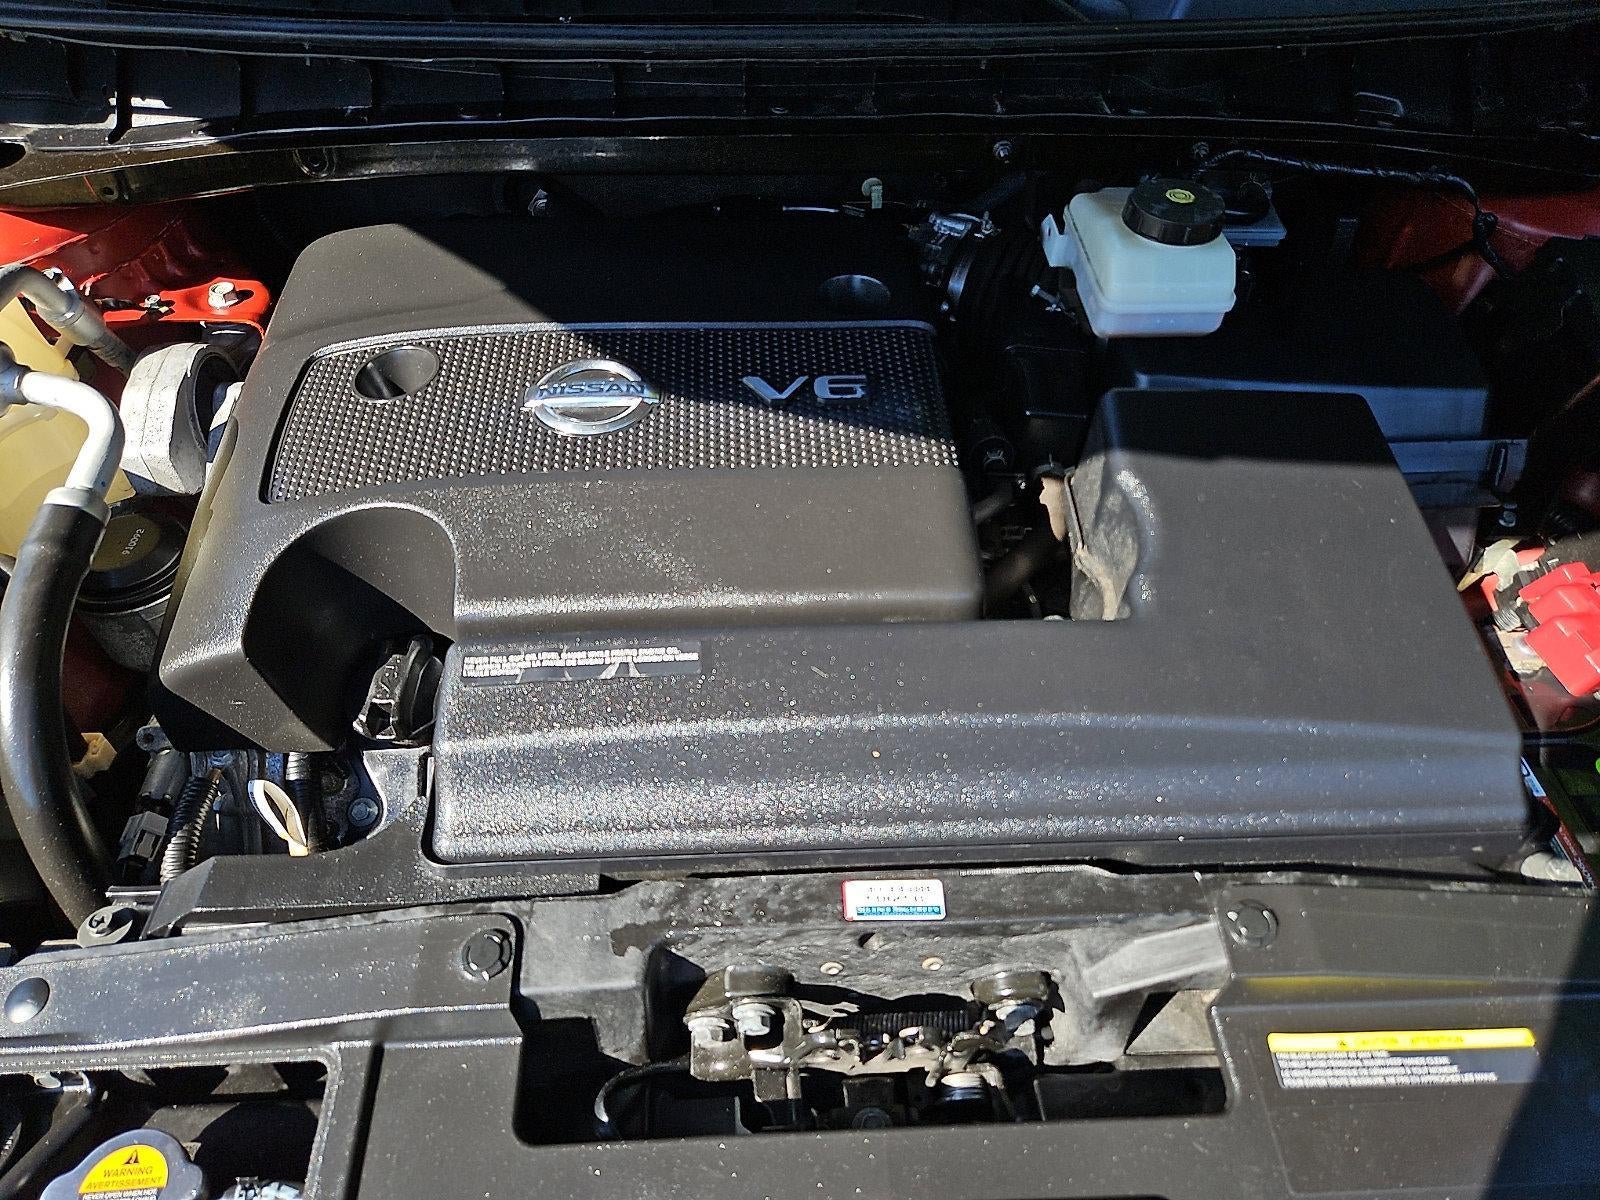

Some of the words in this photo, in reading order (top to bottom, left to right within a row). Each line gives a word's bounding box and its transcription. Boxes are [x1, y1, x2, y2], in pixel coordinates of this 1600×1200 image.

[537, 380, 647, 398] NISSAN
[739, 374, 867, 403] V6
[103, 1165, 153, 1178] WARNING
[86, 1176, 163, 1190] AVERTISSEMENT
